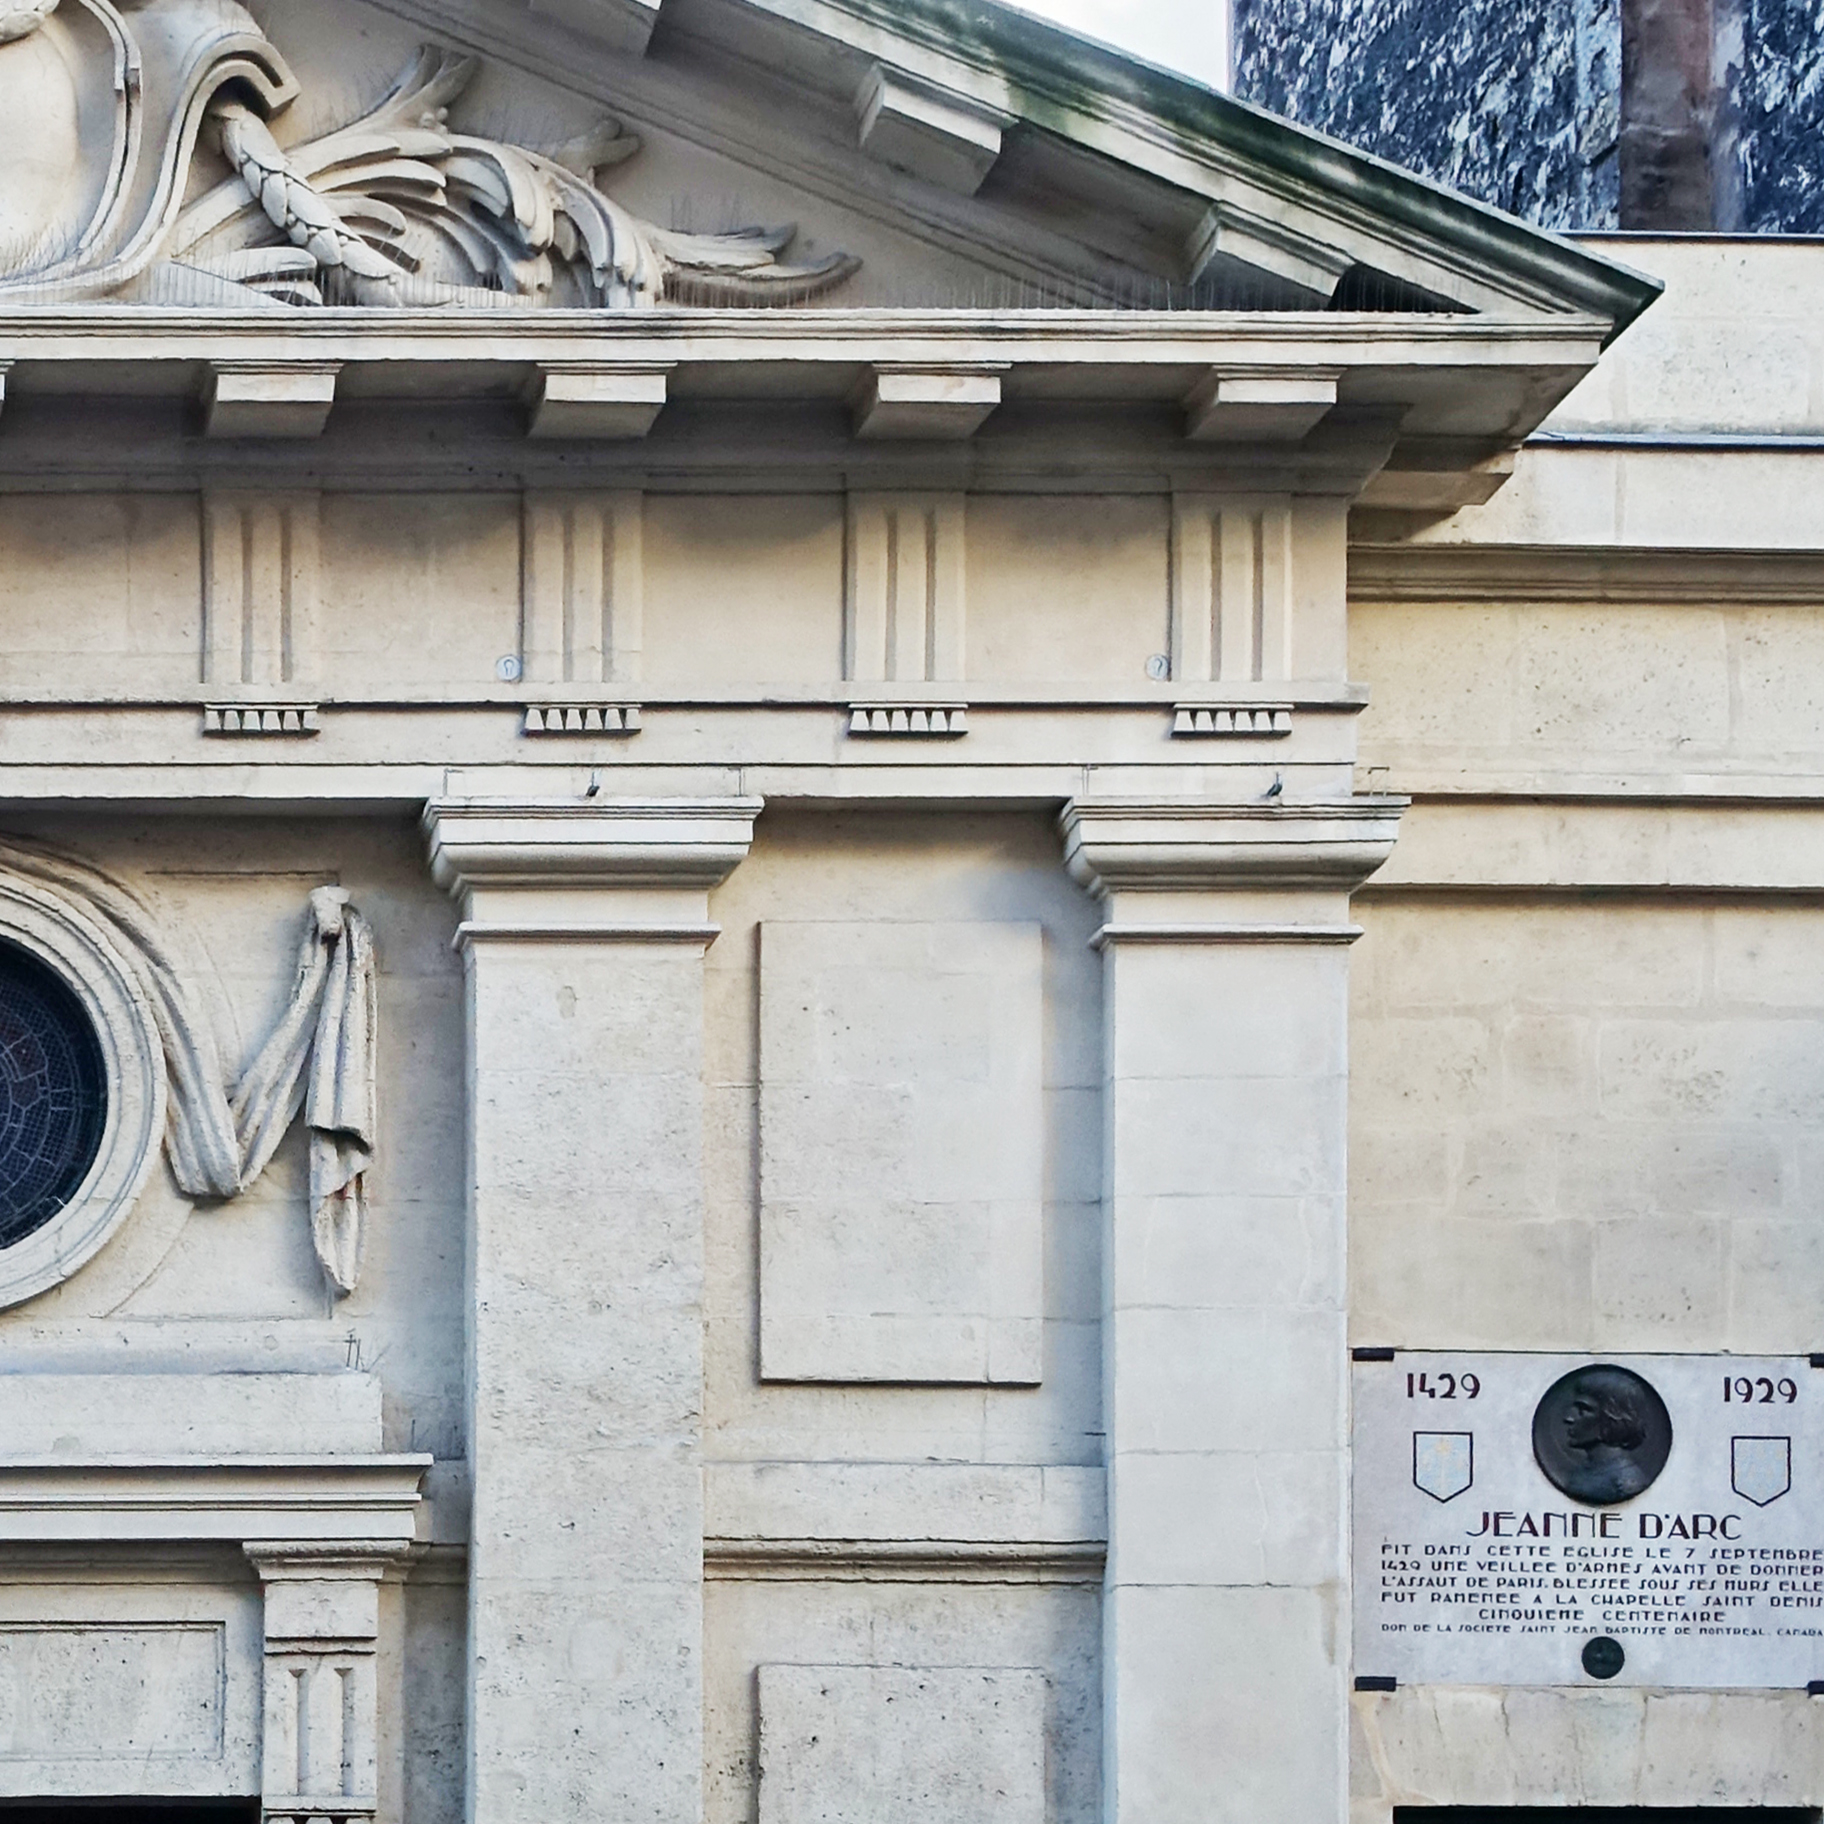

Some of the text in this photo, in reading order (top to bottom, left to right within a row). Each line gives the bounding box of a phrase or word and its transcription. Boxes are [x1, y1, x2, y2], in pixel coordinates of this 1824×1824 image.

[1408, 1373, 1480, 1399] 1429
[1724, 1377, 1797, 1403] 1929
[1466, 1512, 1741, 1540] JEANNE D'ARC
[1382, 1545, 1822, 1560] FIT DANS CETTE EGLISE LE 7 SEPTEMBRE
[1382, 1560, 1420, 1570] 1429
[1432, 1561, 1466, 1571] UNE
[1477, 1561, 1555, 1572] VEILLEE
[1567, 1563, 1641, 1573] D'ARMES
[1653, 1564, 1706, 1575] AVANT
[1717, 1564, 1740, 1575] DE
[1382, 1576, 1456, 1587] L'ASSAUT
[1467, 1578, 1487, 1587] DE
[1553, 1578, 1629, 1589] BLESSEE
[1639, 1579, 1678, 1590] SOUS
[1688, 1580, 1716, 1590] SES
[1725, 1580, 1769, 1591] MURS
[1779, 1581, 1822, 1592] ELLE
[1382, 1592, 1822, 1607] FUT RAMENEE A LA CHAPELLE SAINT DENIS
[1479, 1609, 1725, 1622] CINQUIEME CENTENAIRE
[1605, 1627, 1666, 1636] BAPTISTE
